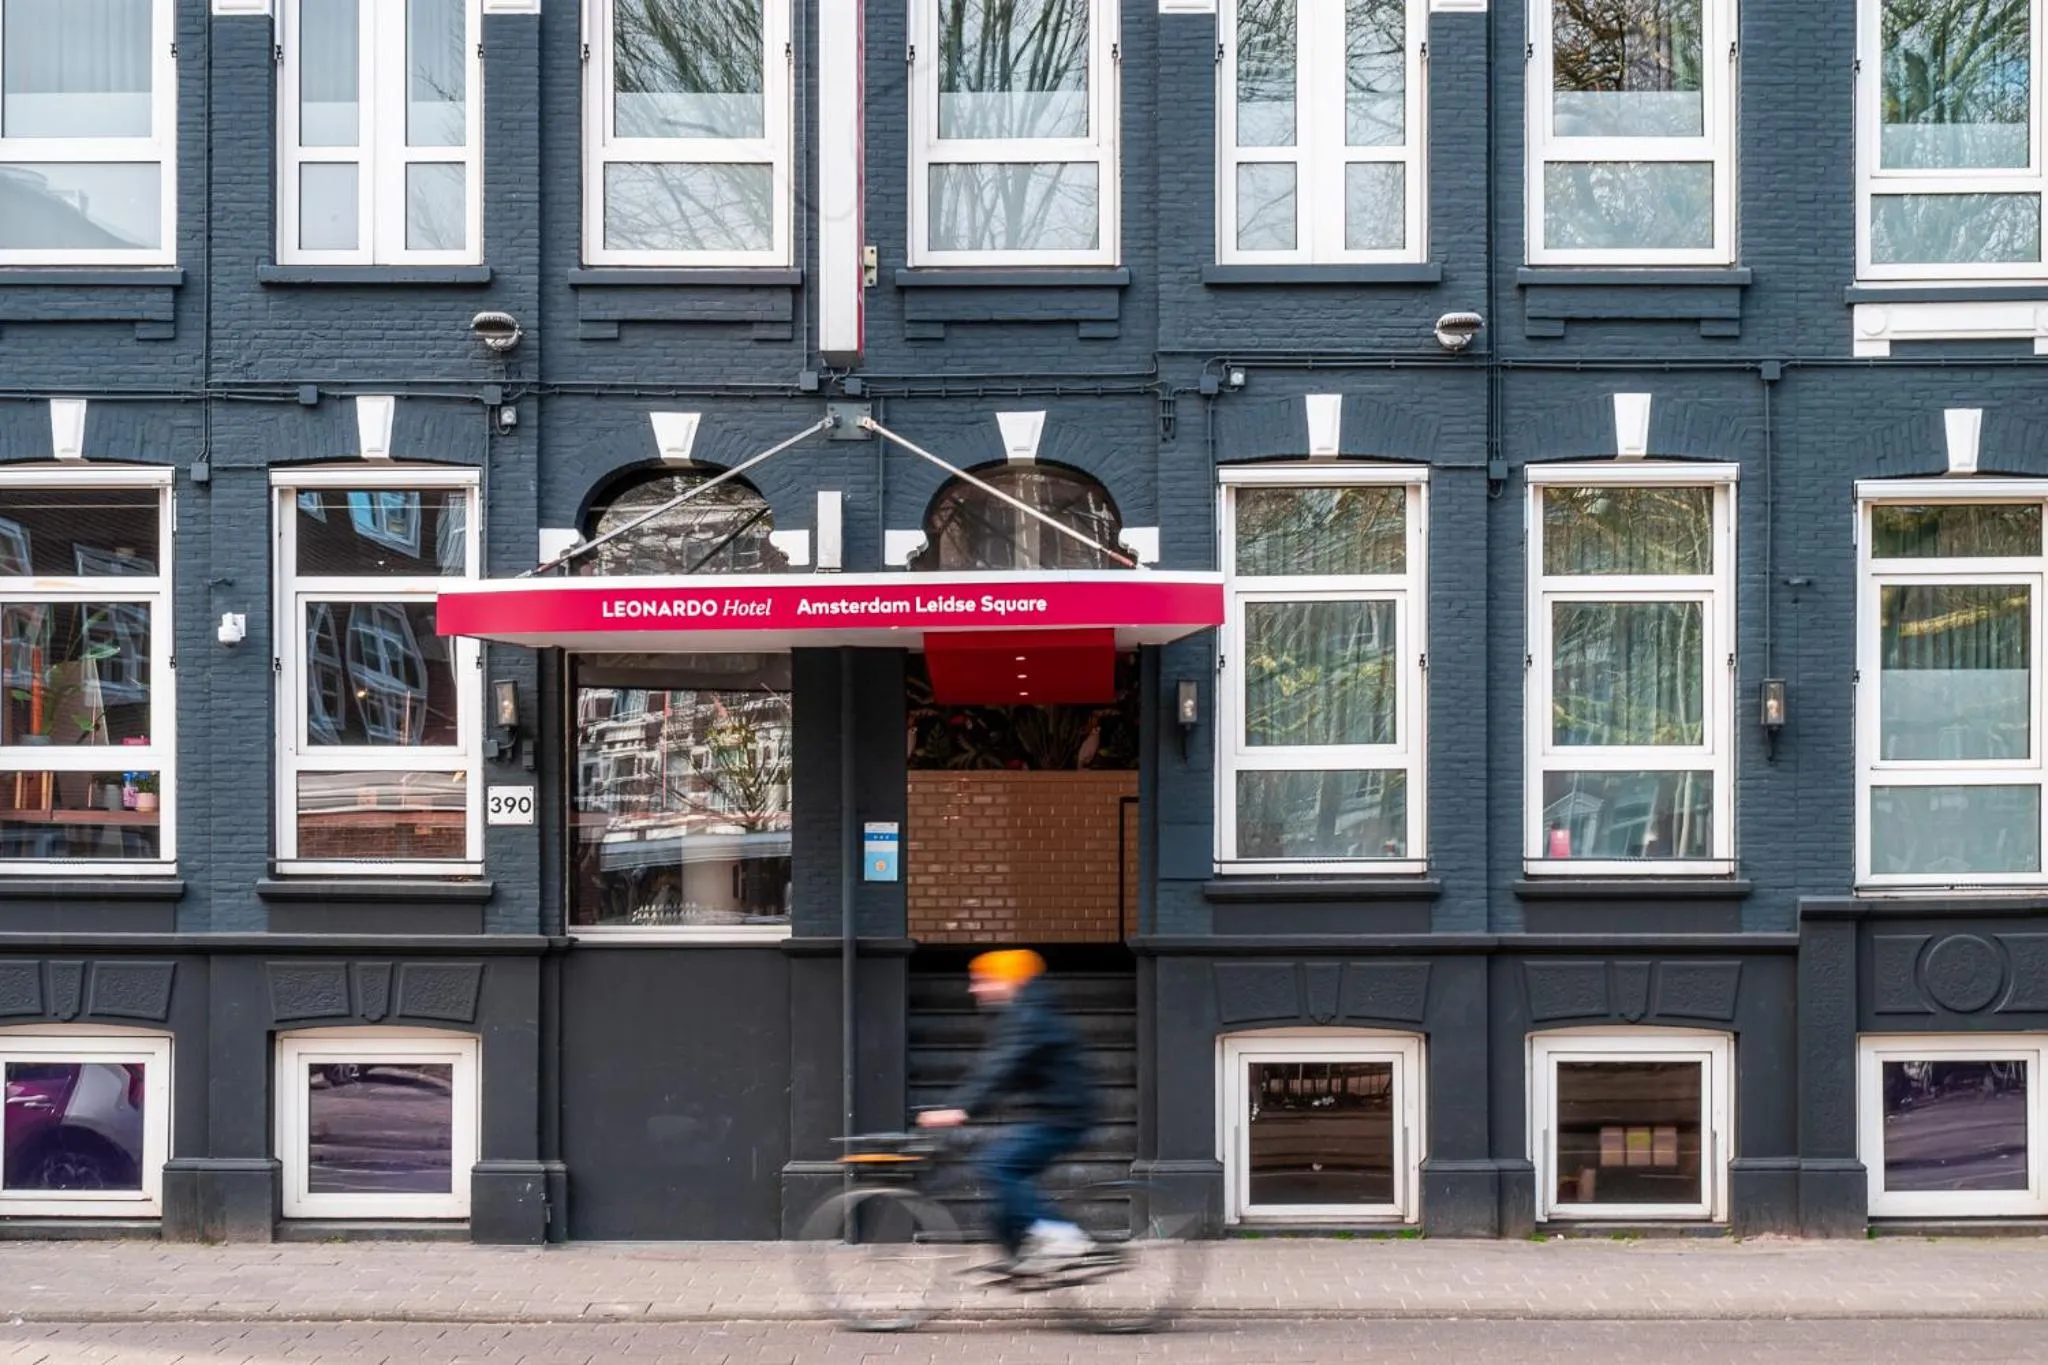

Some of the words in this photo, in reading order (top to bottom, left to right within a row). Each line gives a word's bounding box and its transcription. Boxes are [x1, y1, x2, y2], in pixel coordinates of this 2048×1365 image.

[602, 600, 717, 618] LEONARDO
[722, 598, 772, 616] Hotel
[796, 598, 911, 615] Amsterdam
[915, 596, 976, 613] Leidse
[981, 595, 1048, 615] Square
[490, 796, 532, 814] 390
